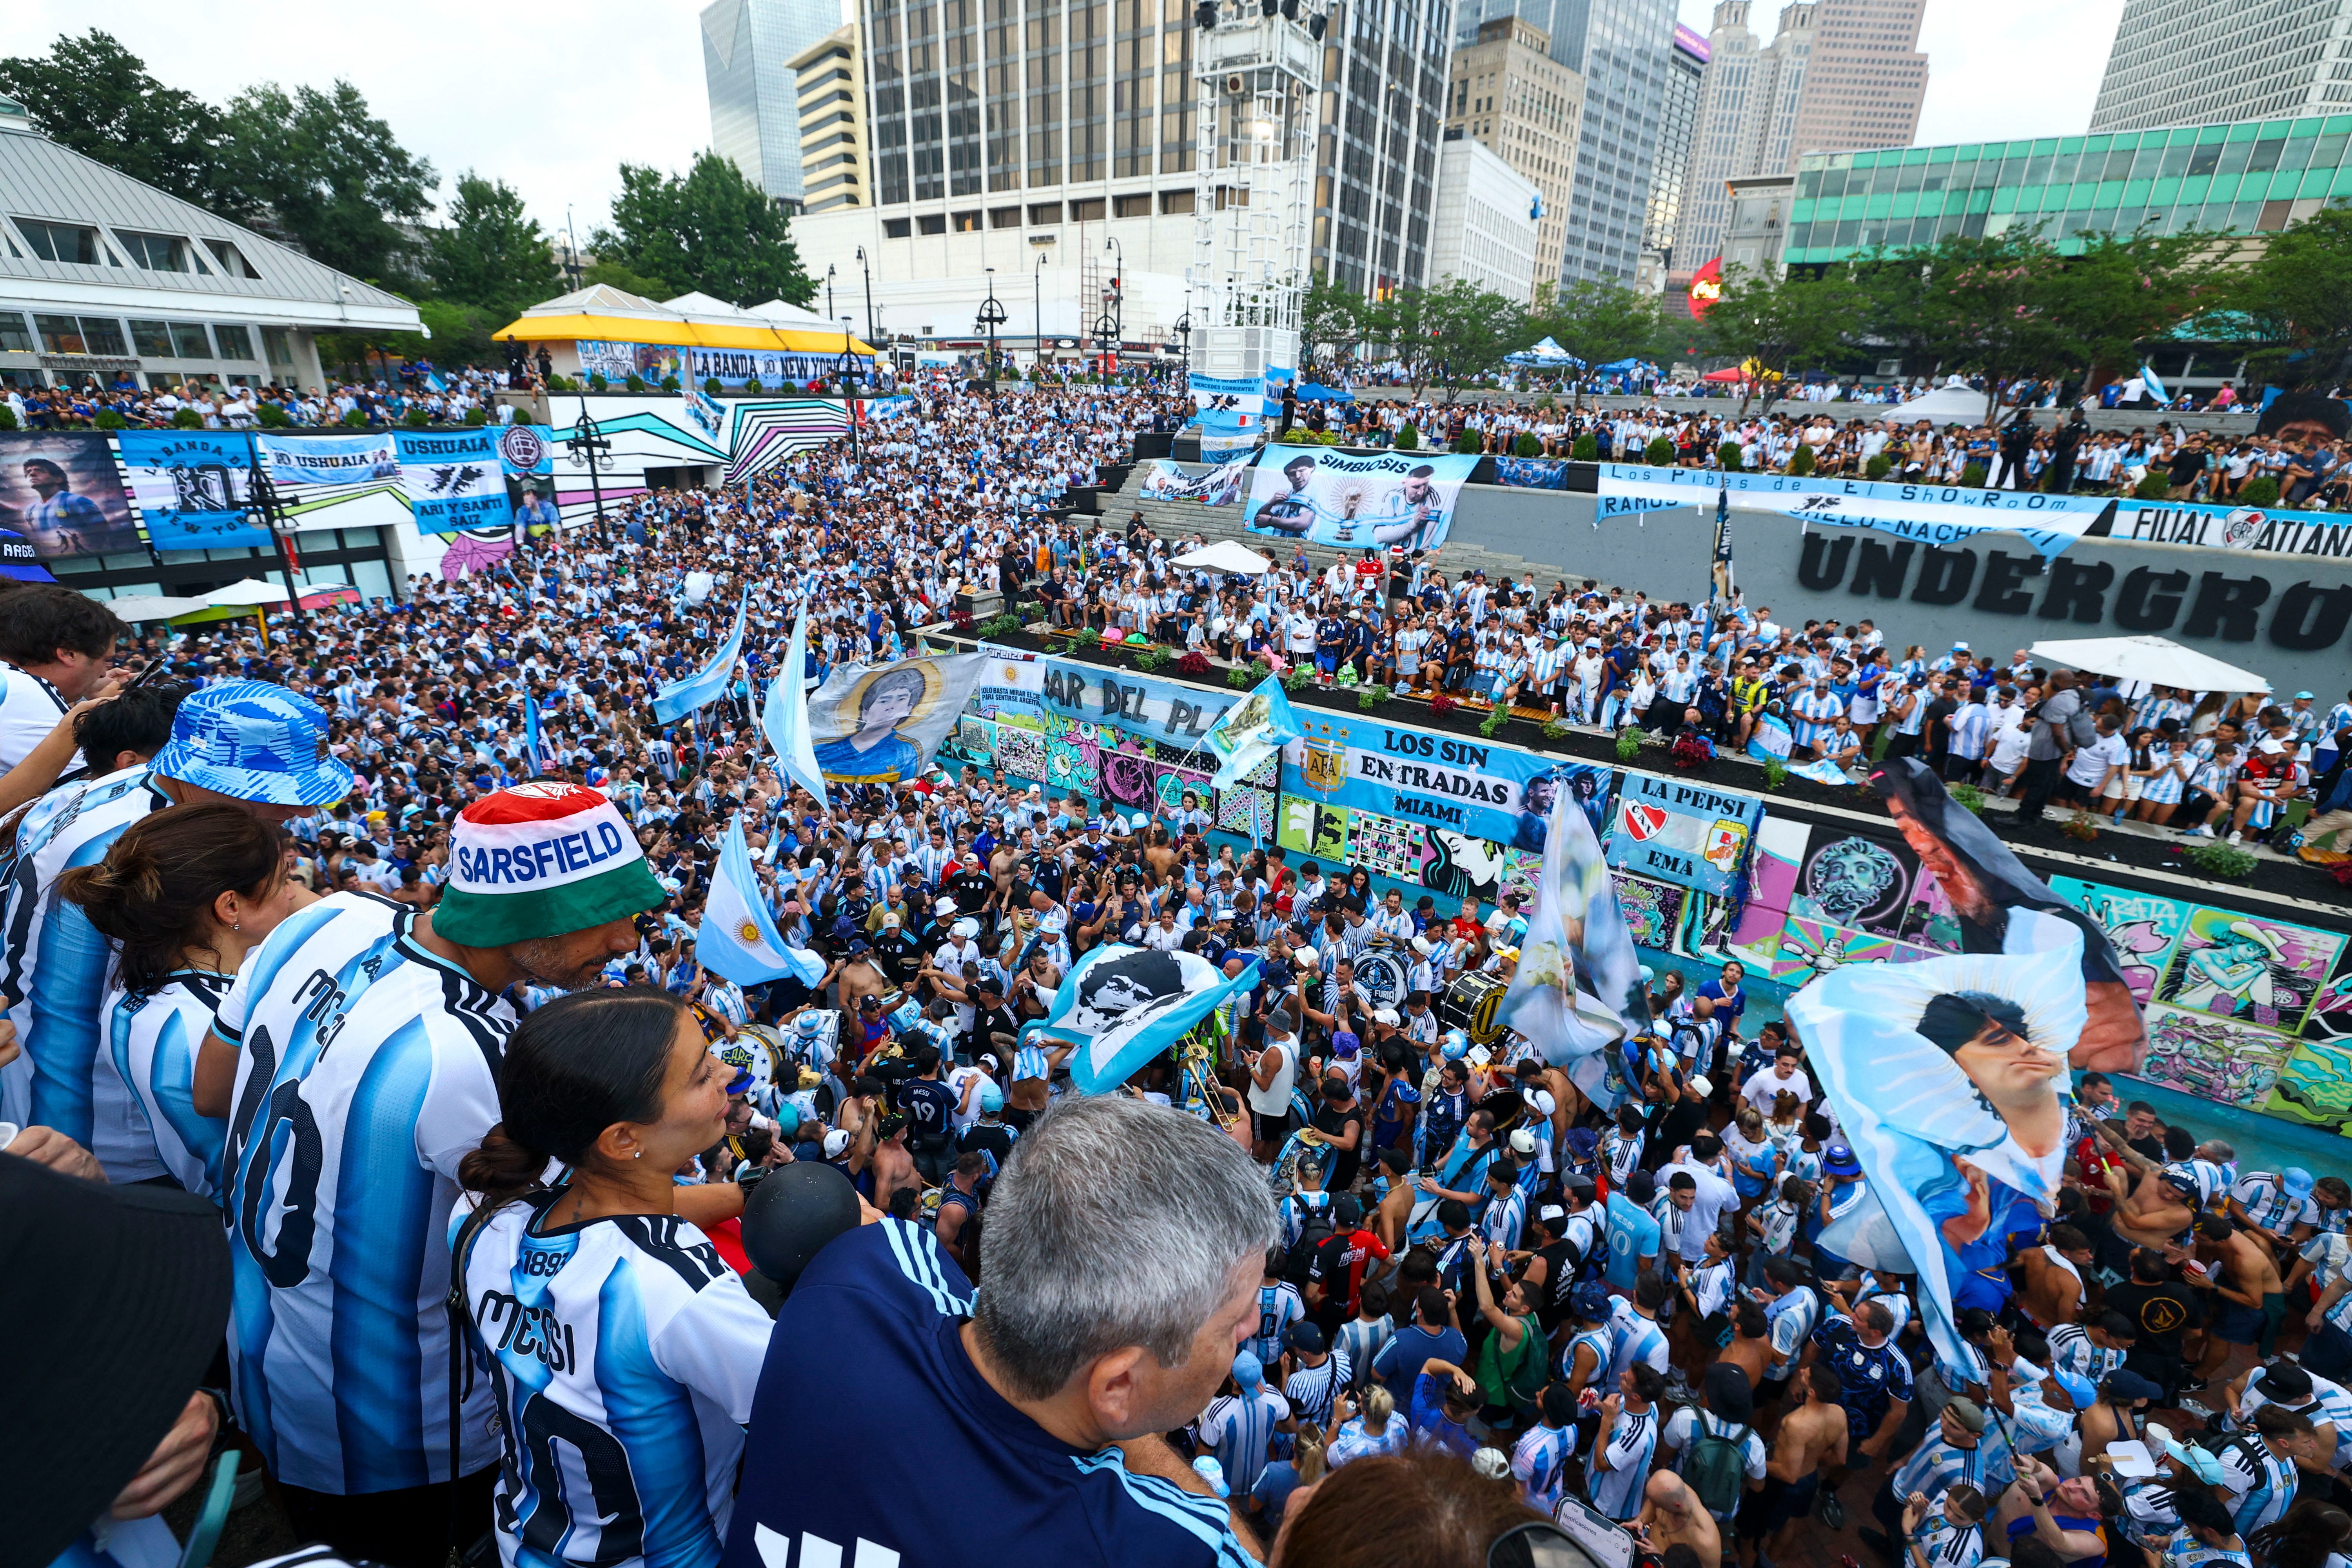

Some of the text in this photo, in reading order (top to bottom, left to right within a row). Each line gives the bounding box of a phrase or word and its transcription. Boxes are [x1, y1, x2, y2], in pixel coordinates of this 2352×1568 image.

[692, 352, 710, 377] LA
[714, 353, 759, 379] BANDA
[780, 356, 809, 380] NEW
[1194, 382, 1221, 390] MERCEDES
[163, 441, 222, 457] BANDA
[403, 437, 490, 455] USHUAIA
[296, 454, 369, 468] USHUAIA
[1319, 454, 1410, 474] SIMBIOSIS
[1611, 465, 1651, 480] Los
[1774, 475, 1801, 491] de
[420, 498, 503, 516] ARI Y SANTI
[450, 514, 481, 527] SAIZ
[2132, 508, 2212, 545] FILIAL
[1103, 679, 1149, 724] DEL
[652, 751, 669, 764] 10
[1385, 730, 1489, 769] LOS SIN
[1361, 755, 1508, 805] ENTRADAS
[1395, 796, 1462, 824] MIAMI
[1641, 779, 1747, 818] LA PEPSI
[459, 821, 622, 884] SARSFIELD
[1372, 840, 1395, 852] CATS
[1646, 849, 1693, 876] EMA
[1374, 988, 1396, 1002] FURIA
[1474, 1032, 1497, 1042] ROSARIO
[913, 1089, 930, 1097] MESSI
[1187, 1081, 1199, 1097] 10
[911, 1100, 935, 1122] 19
[223, 1024, 324, 1289] 10
[1612, 1210, 1635, 1232] MESSI
[524, 1250, 567, 1277] 1893
[477, 1289, 575, 1376] MESSI
[485, 1346, 644, 1563] 10
[1563, 1512, 1597, 1536] Notificaciones
